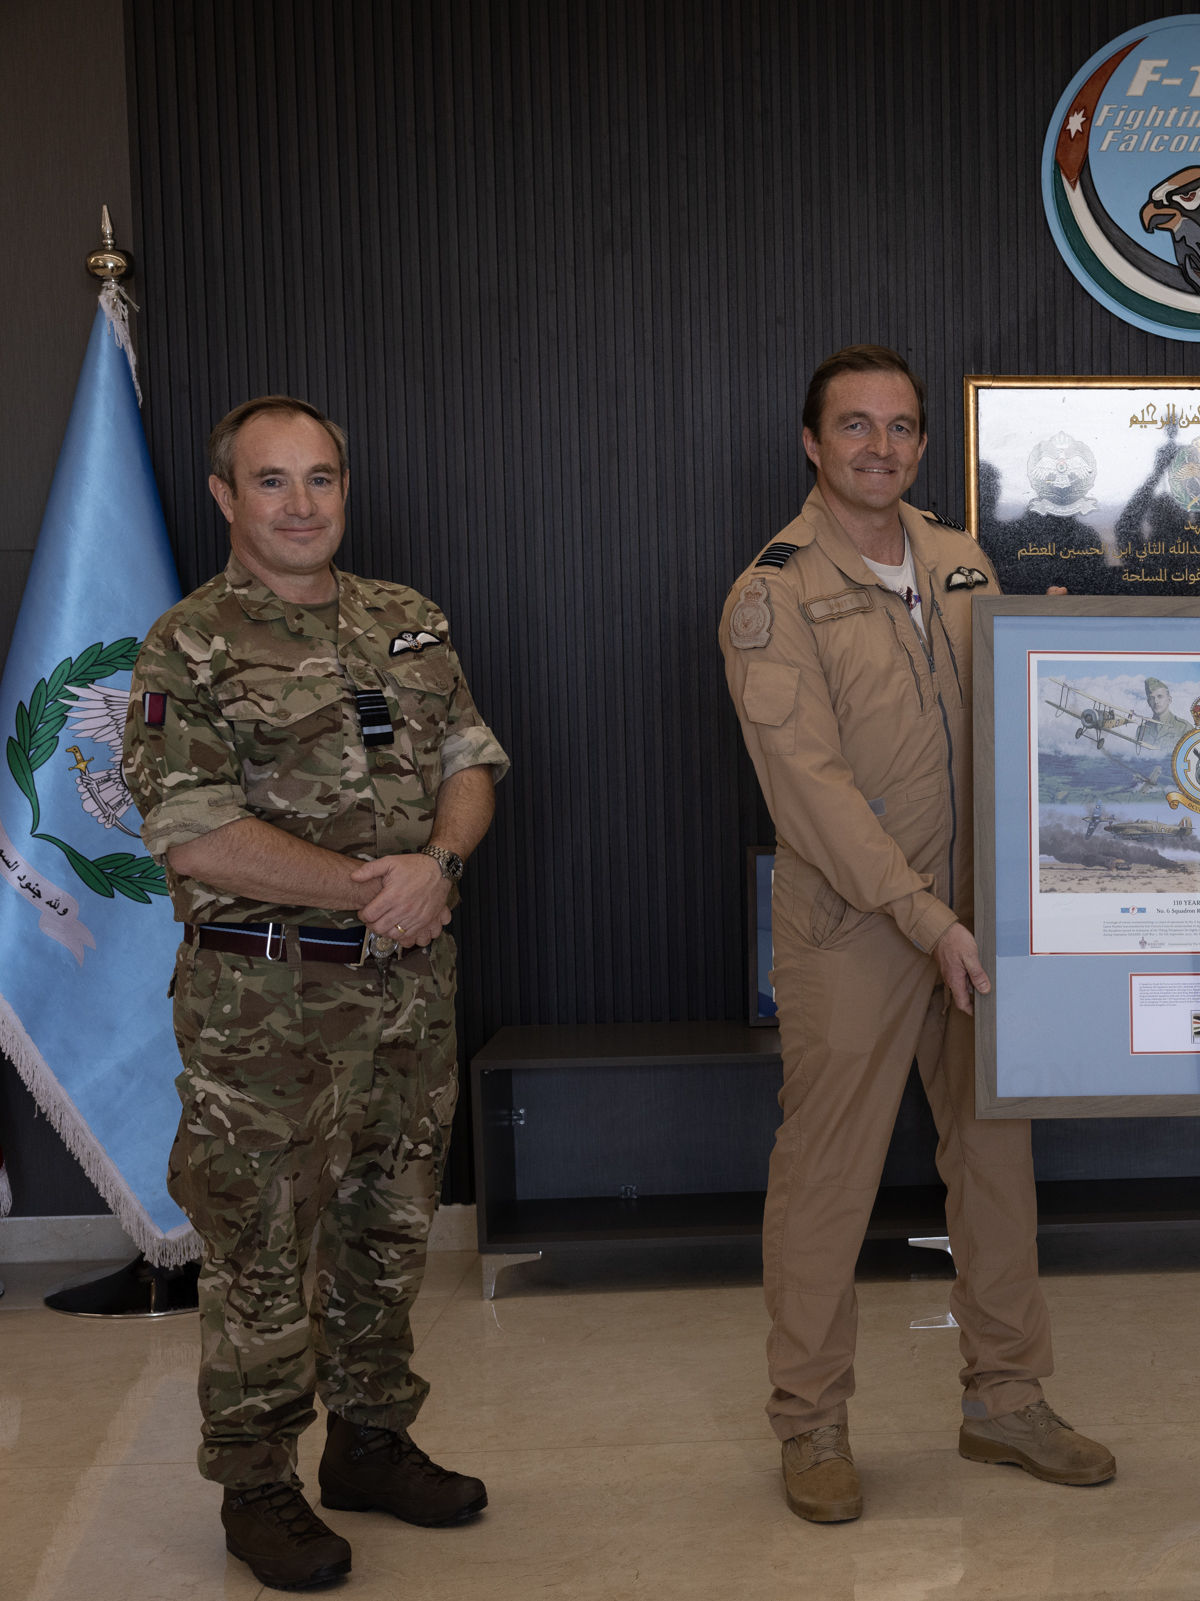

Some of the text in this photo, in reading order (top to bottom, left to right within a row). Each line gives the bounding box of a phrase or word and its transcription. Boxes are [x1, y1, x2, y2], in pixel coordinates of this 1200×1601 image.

[1128, 402, 1176, 429] الرحيم
[1017, 542, 1056, 560] المعظم
[1059, 542, 1109, 559] الحسين
[1112, 541, 1132, 558] ابن
[1135, 541, 1165, 562] الثاني
[1122, 568, 1167, 582] المسلحة
[17, 874, 42, 899] جنود
